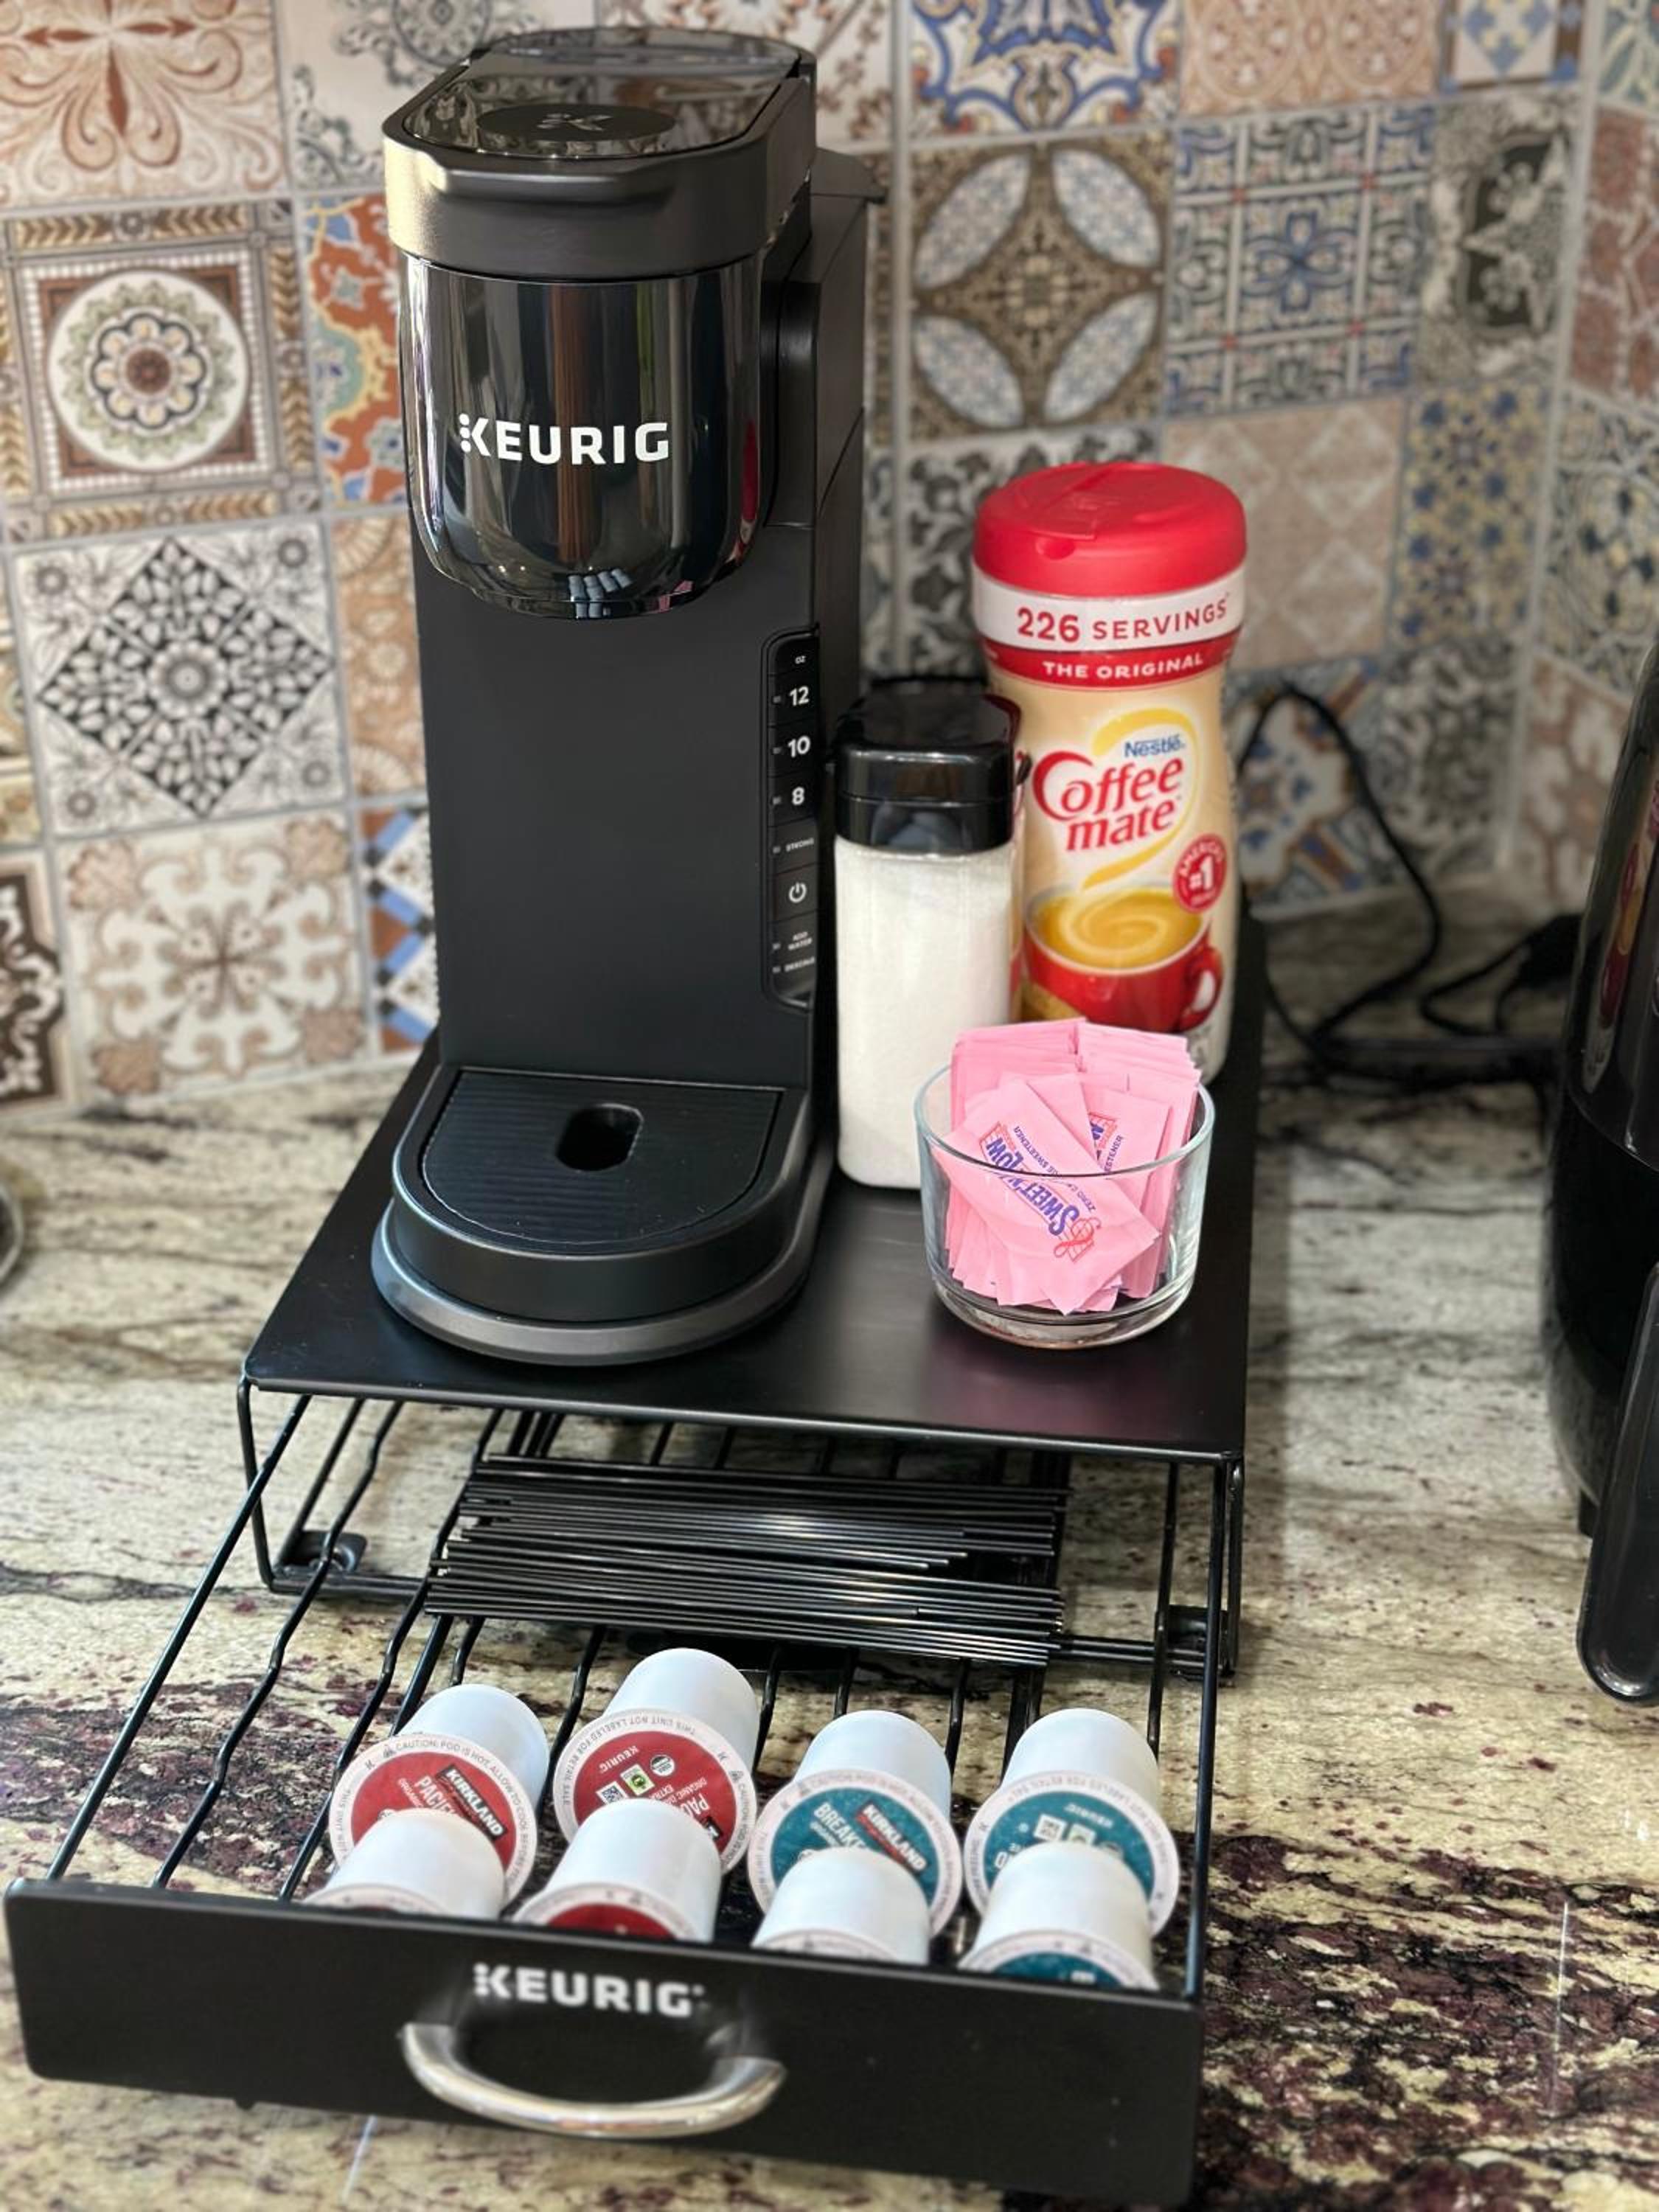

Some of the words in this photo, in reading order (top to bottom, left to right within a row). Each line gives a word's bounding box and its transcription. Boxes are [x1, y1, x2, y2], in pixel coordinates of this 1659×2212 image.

[459, 413, 669, 465] KEURIG
[1018, 607, 1081, 643] 226
[1042, 660, 1088, 679] THE
[1096, 652, 1203, 679] ORIGINAL
[789, 686, 810, 706] 12
[787, 735, 810, 758] 10
[792, 786, 805, 806] 8
[1032, 750, 1184, 821] Coffee
[1066, 799, 1175, 851] mate
[599, 1745, 640, 1773] KEURIG
[414, 1775, 456, 1815] PACIF
[445, 1767, 505, 1836] KIRKLAND
[863, 1804, 927, 1871] KIRKLAND
[473, 1962, 693, 2017] KEURIG
